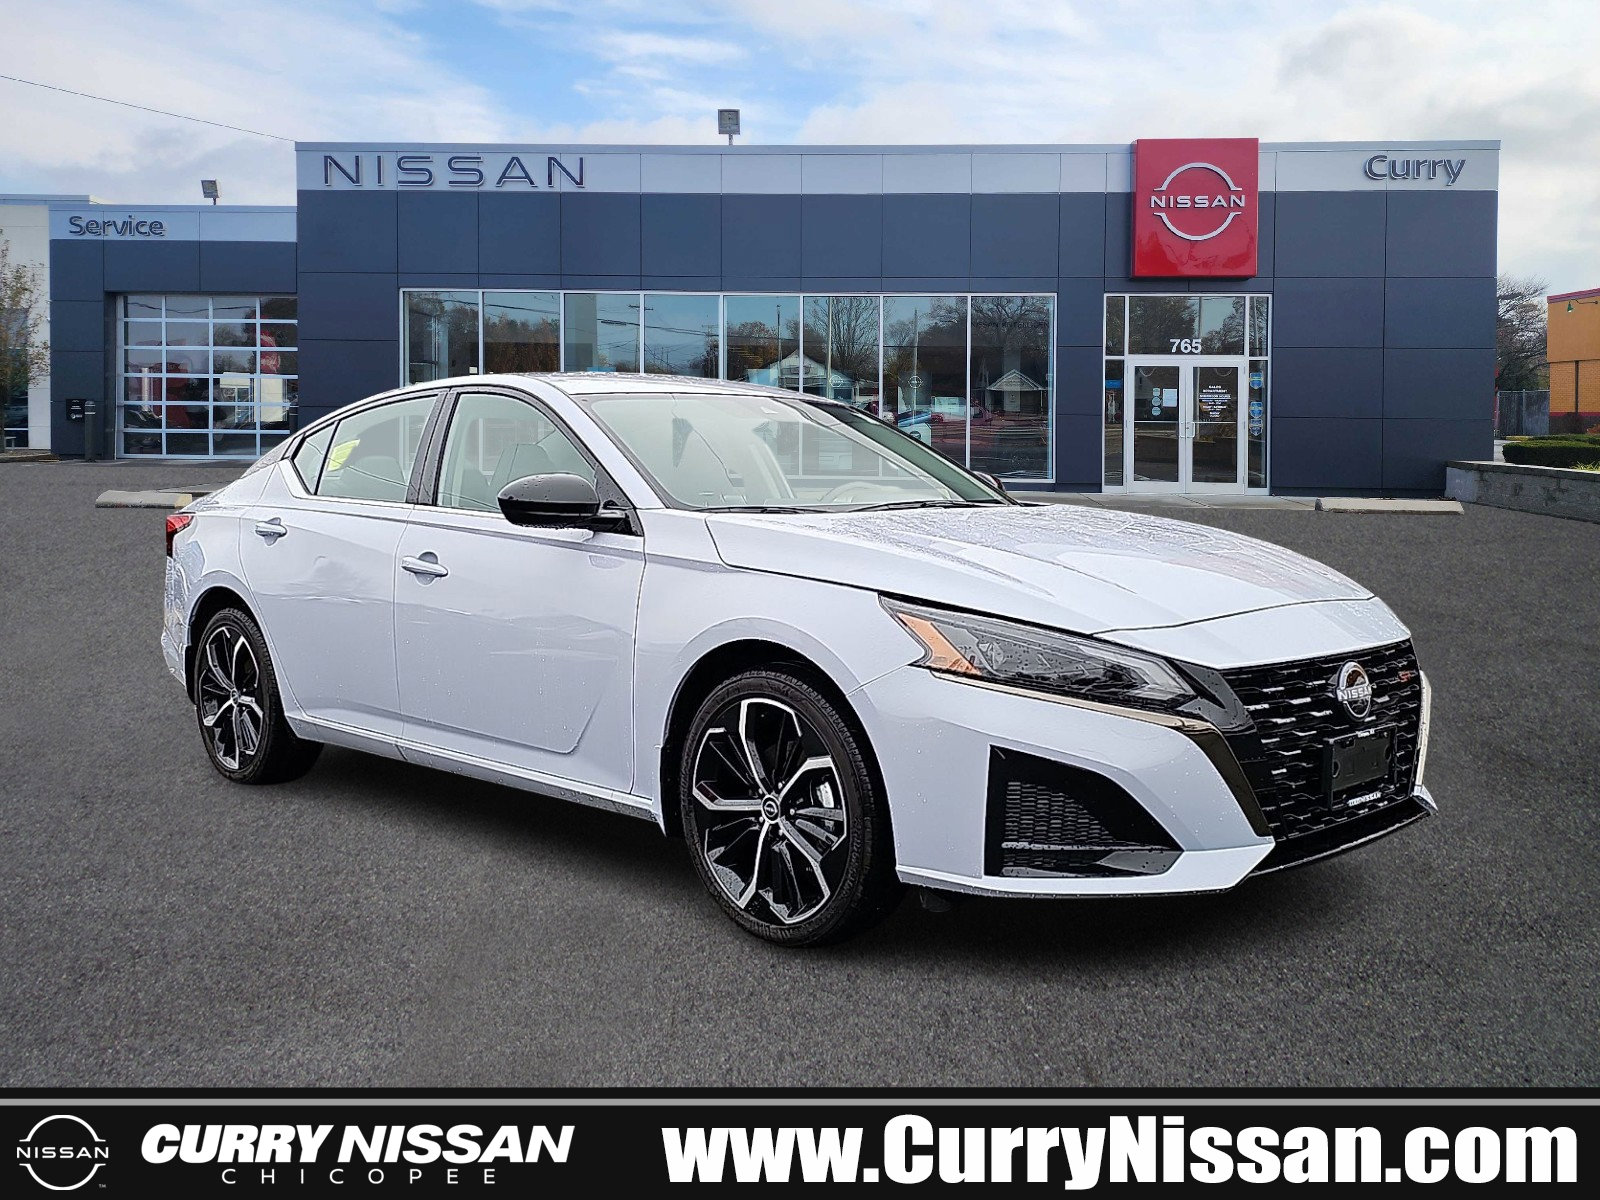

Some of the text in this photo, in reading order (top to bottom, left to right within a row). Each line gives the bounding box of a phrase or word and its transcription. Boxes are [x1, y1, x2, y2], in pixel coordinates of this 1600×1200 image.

[324, 156, 585, 188] NISSAN
[1364, 155, 1466, 186] Curry
[1150, 194, 1246, 208] NISSAN
[69, 214, 165, 236] Service
[1169, 338, 1202, 354] 765
